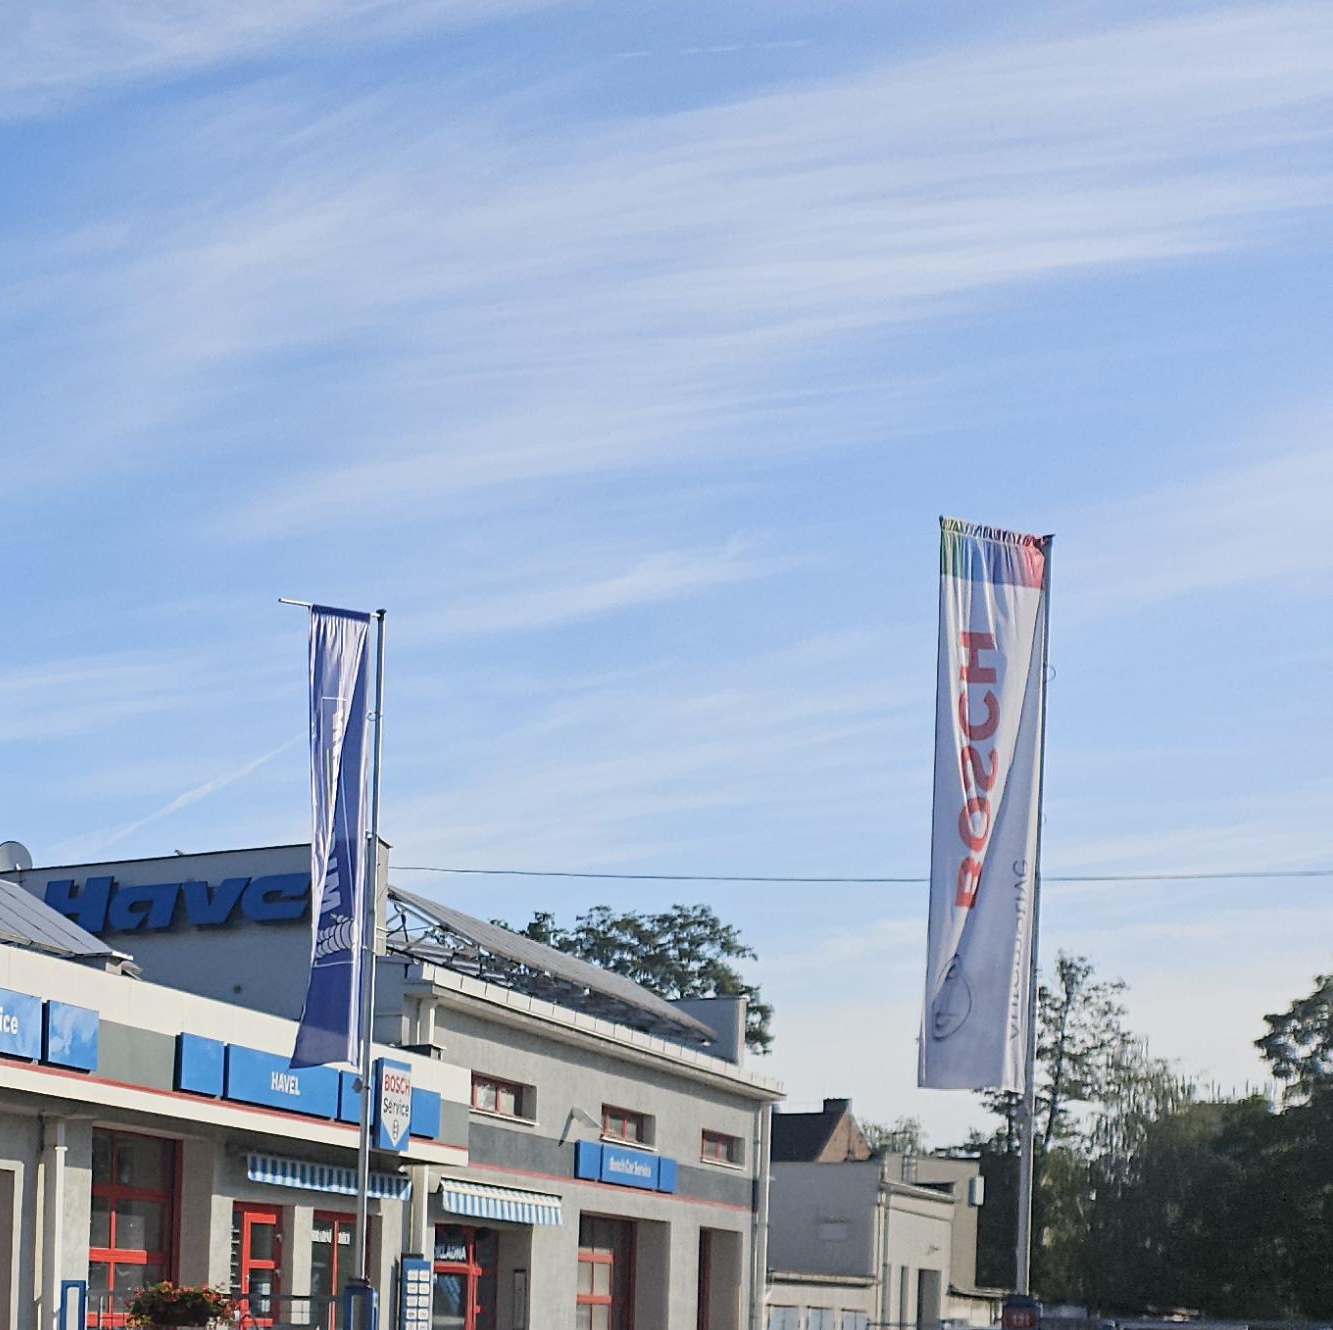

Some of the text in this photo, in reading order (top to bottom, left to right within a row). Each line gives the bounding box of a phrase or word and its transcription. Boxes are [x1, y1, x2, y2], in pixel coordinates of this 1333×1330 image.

[44, 872, 312, 933] Have
[270, 1071, 301, 1096] HAVEL
[384, 1073, 411, 1094] BOSCH
[383, 1097, 409, 1117] Service
